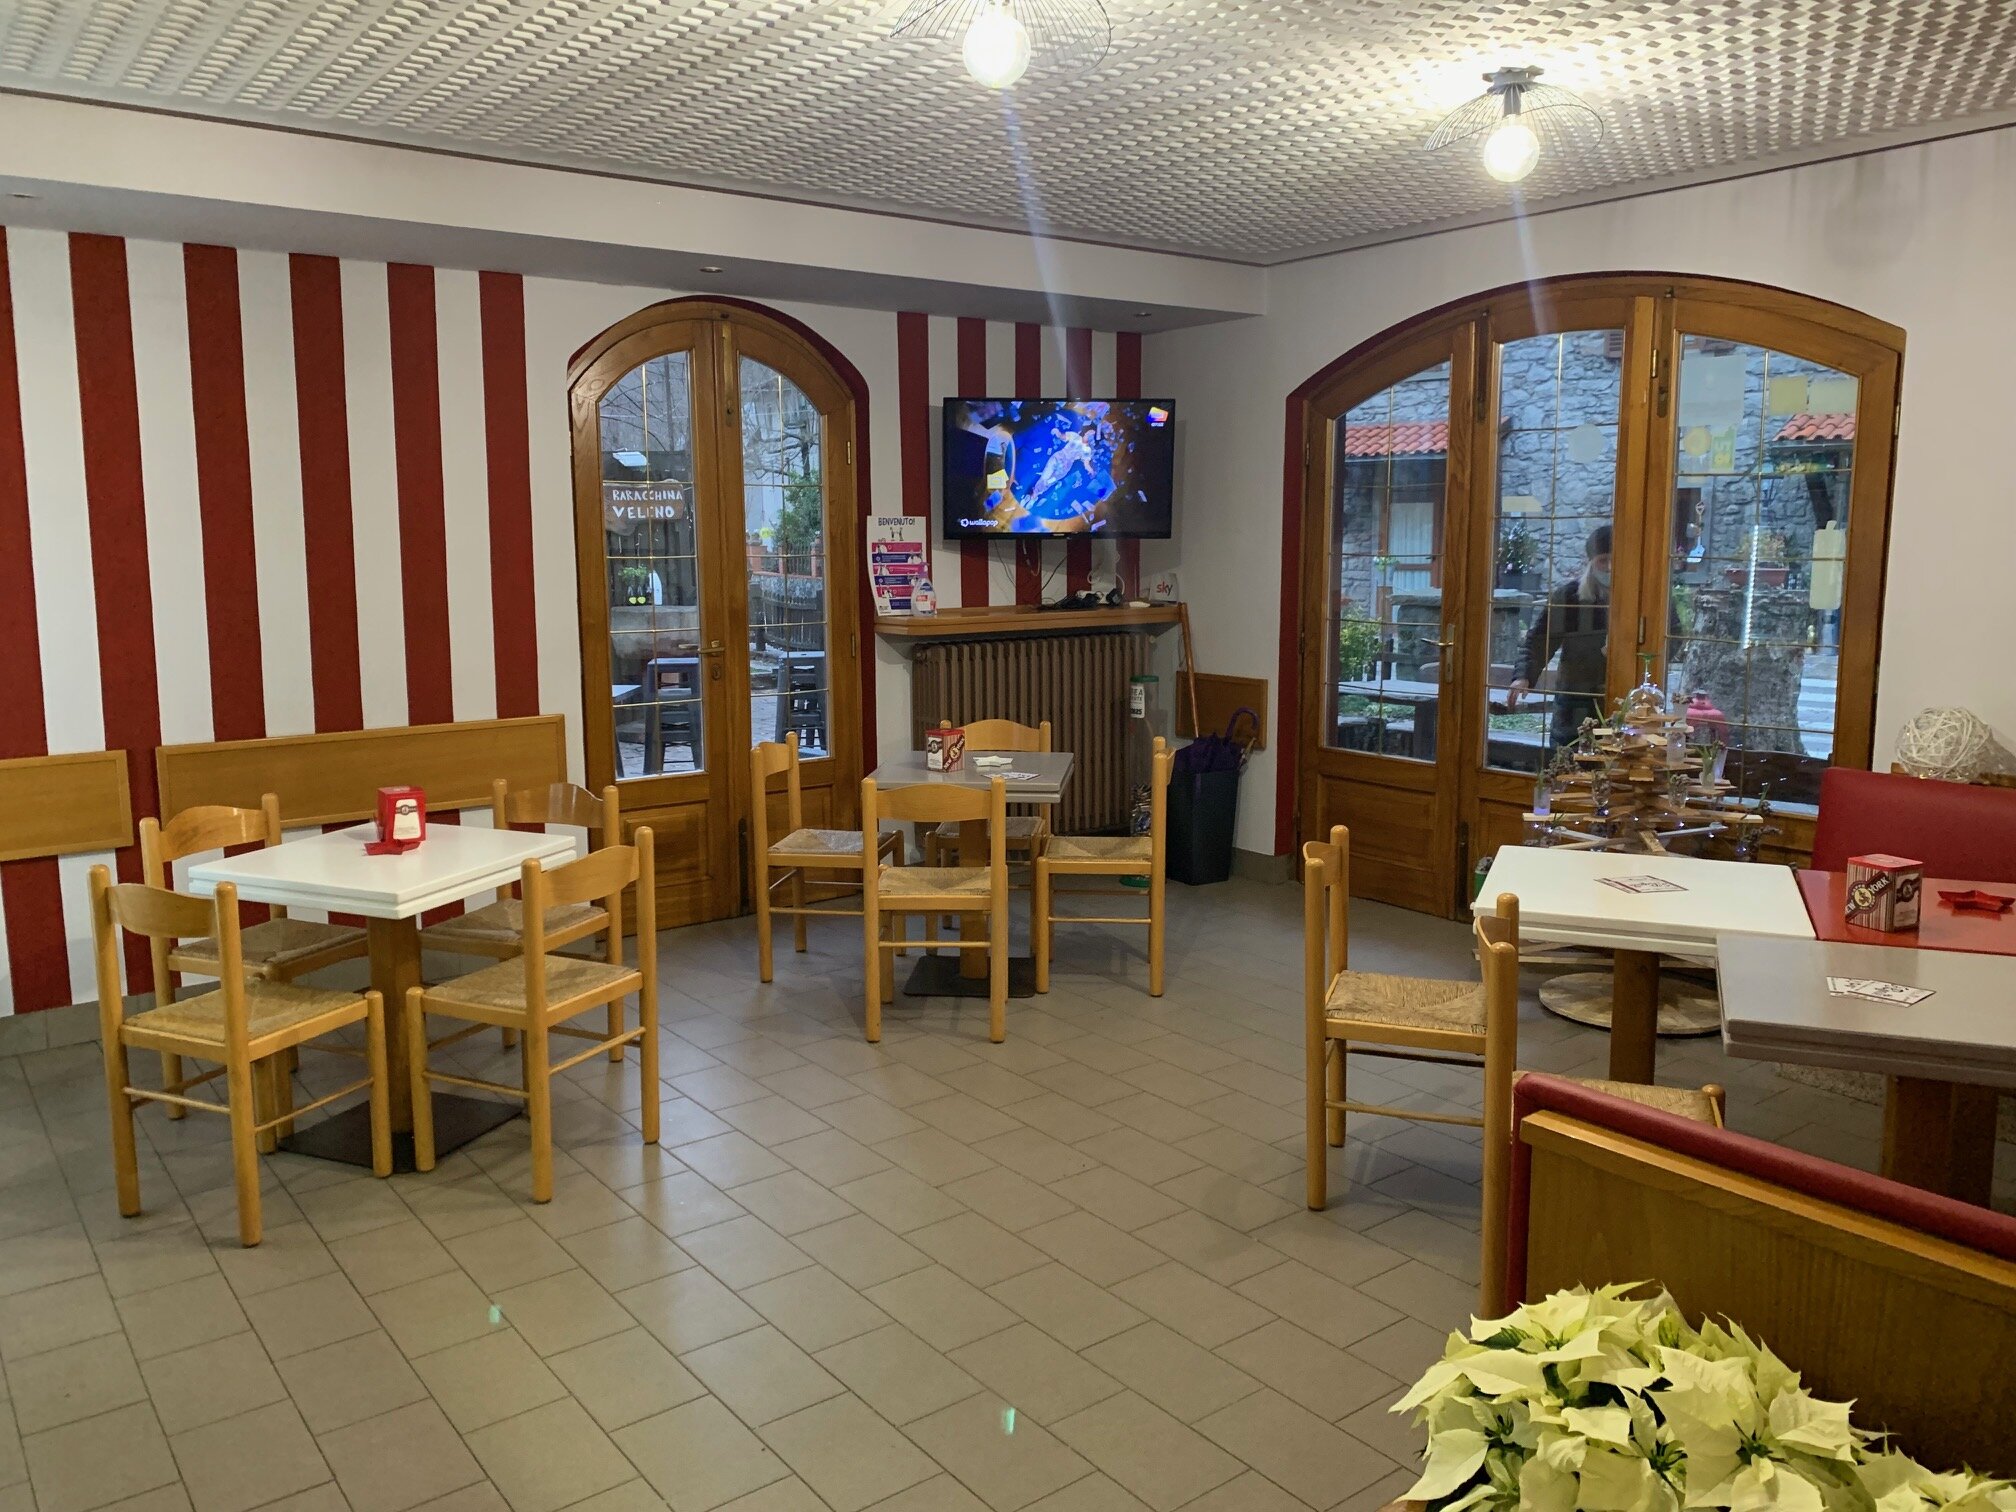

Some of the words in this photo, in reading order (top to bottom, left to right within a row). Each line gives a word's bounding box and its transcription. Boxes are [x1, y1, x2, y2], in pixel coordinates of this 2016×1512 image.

[612, 489, 683, 501] BARACCHINA
[969, 518, 999, 527] wallapop
[1156, 580, 1173, 596] sky
[1868, 876, 1891, 894] YORK
